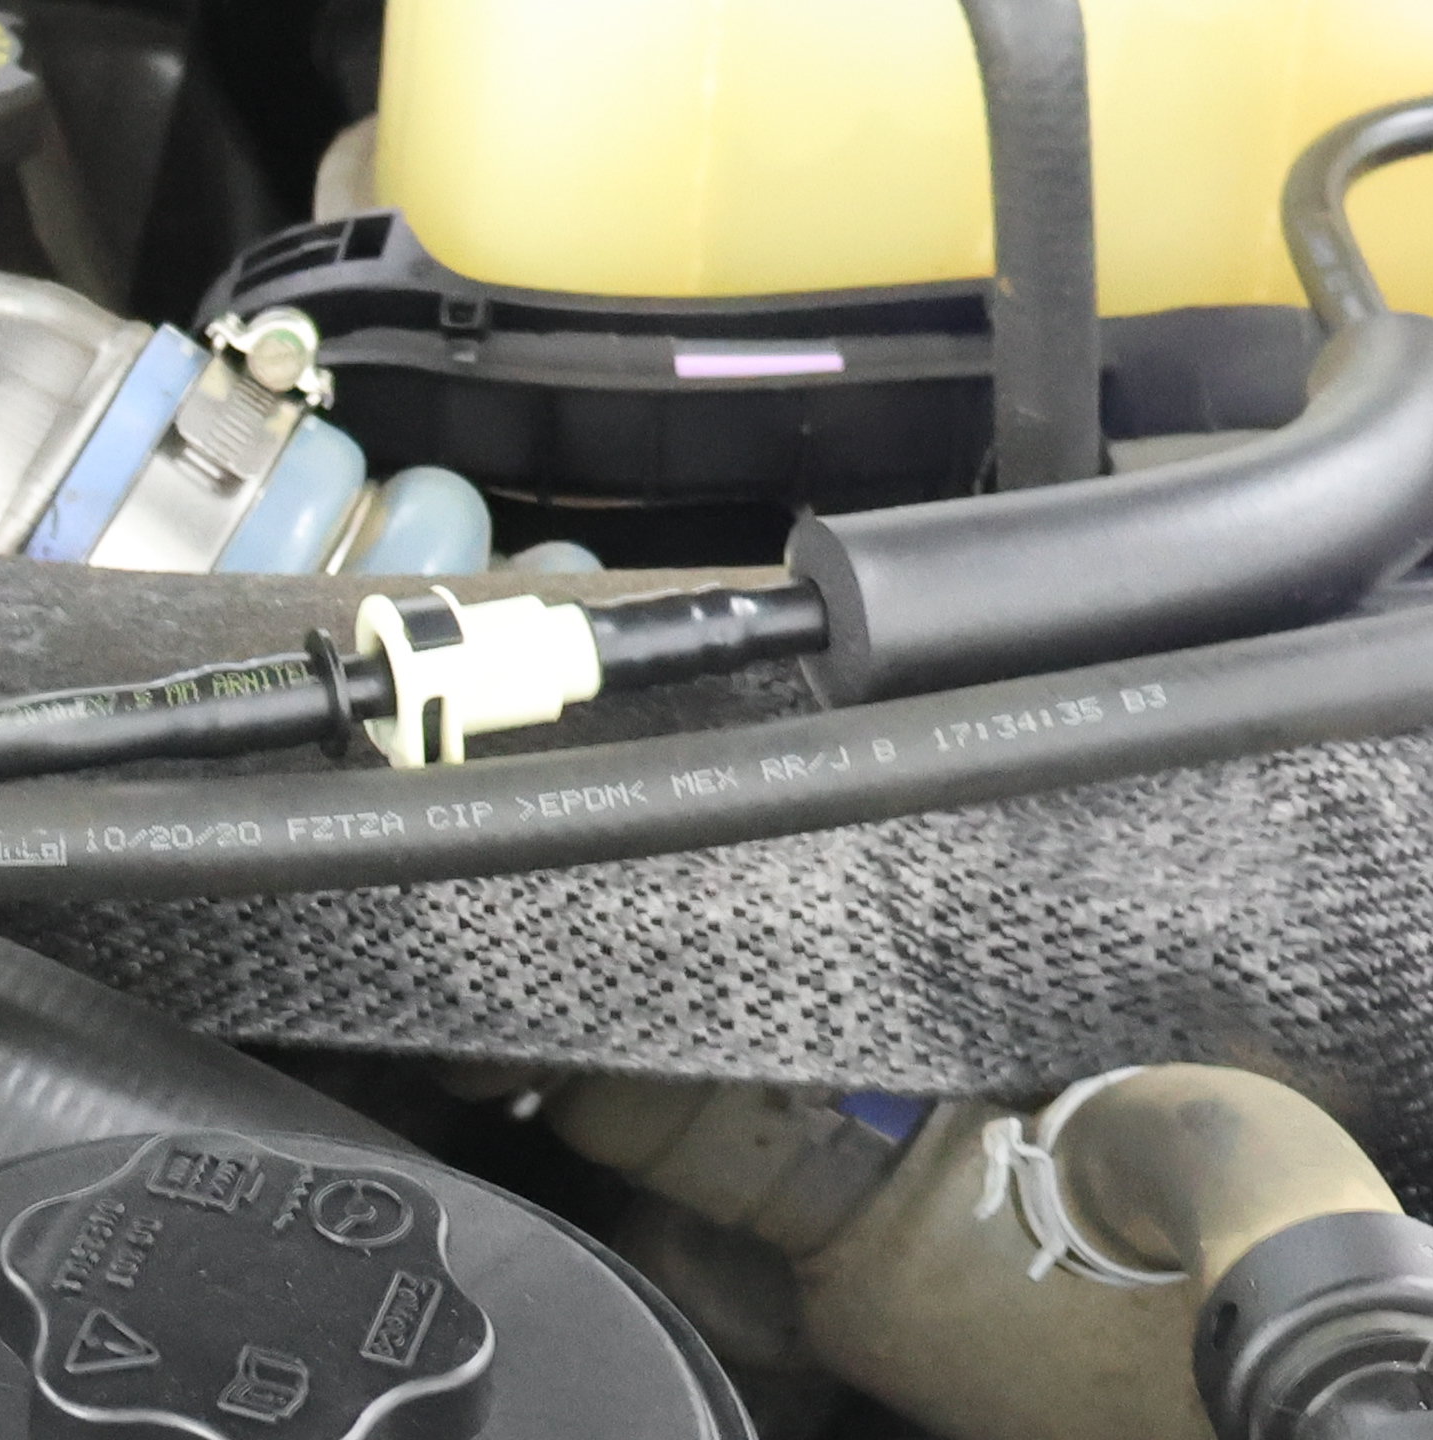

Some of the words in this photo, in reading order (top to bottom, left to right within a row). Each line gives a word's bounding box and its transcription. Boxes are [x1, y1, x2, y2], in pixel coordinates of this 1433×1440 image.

[86, 820, 263, 854] 10/20/20
[426, 801, 495, 833] CIP
[671, 763, 740, 800] MEX
